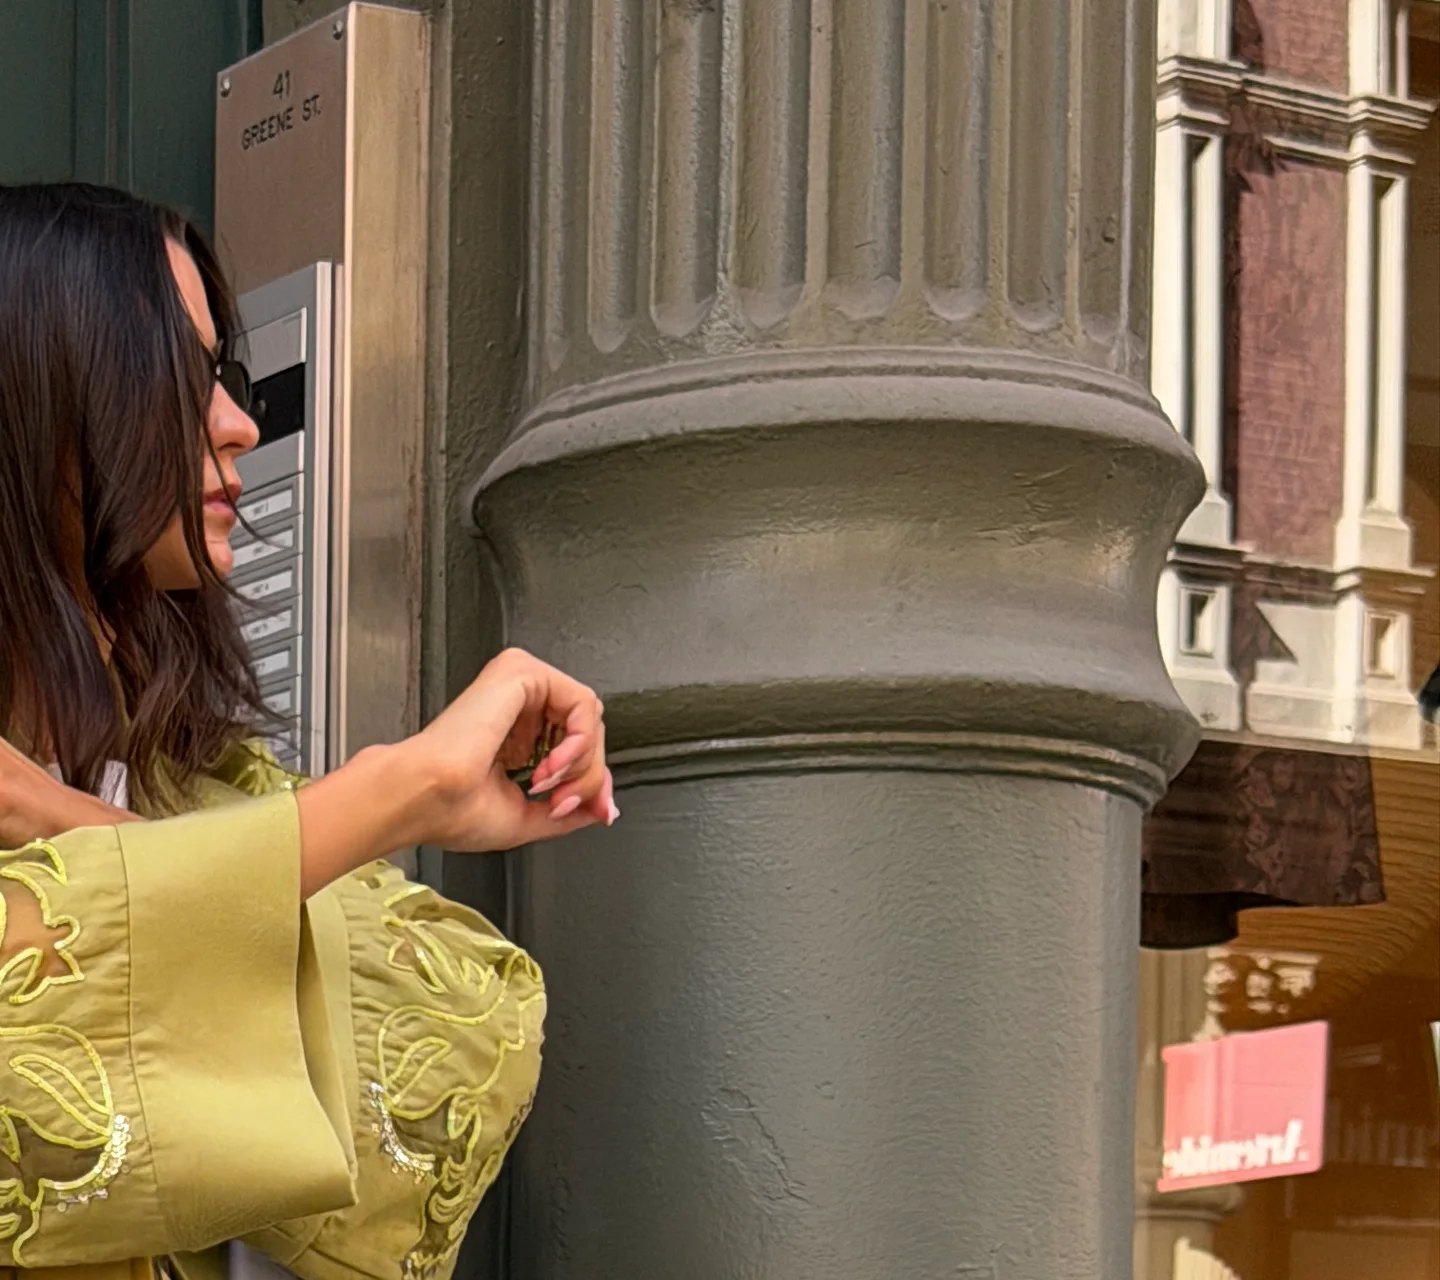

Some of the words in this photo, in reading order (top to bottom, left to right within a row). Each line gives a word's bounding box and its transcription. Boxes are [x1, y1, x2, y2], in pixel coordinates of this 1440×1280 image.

[272, 70, 291, 99] 41
[241, 107, 294, 150] GREENE
[301, 94, 322, 122] ST.
